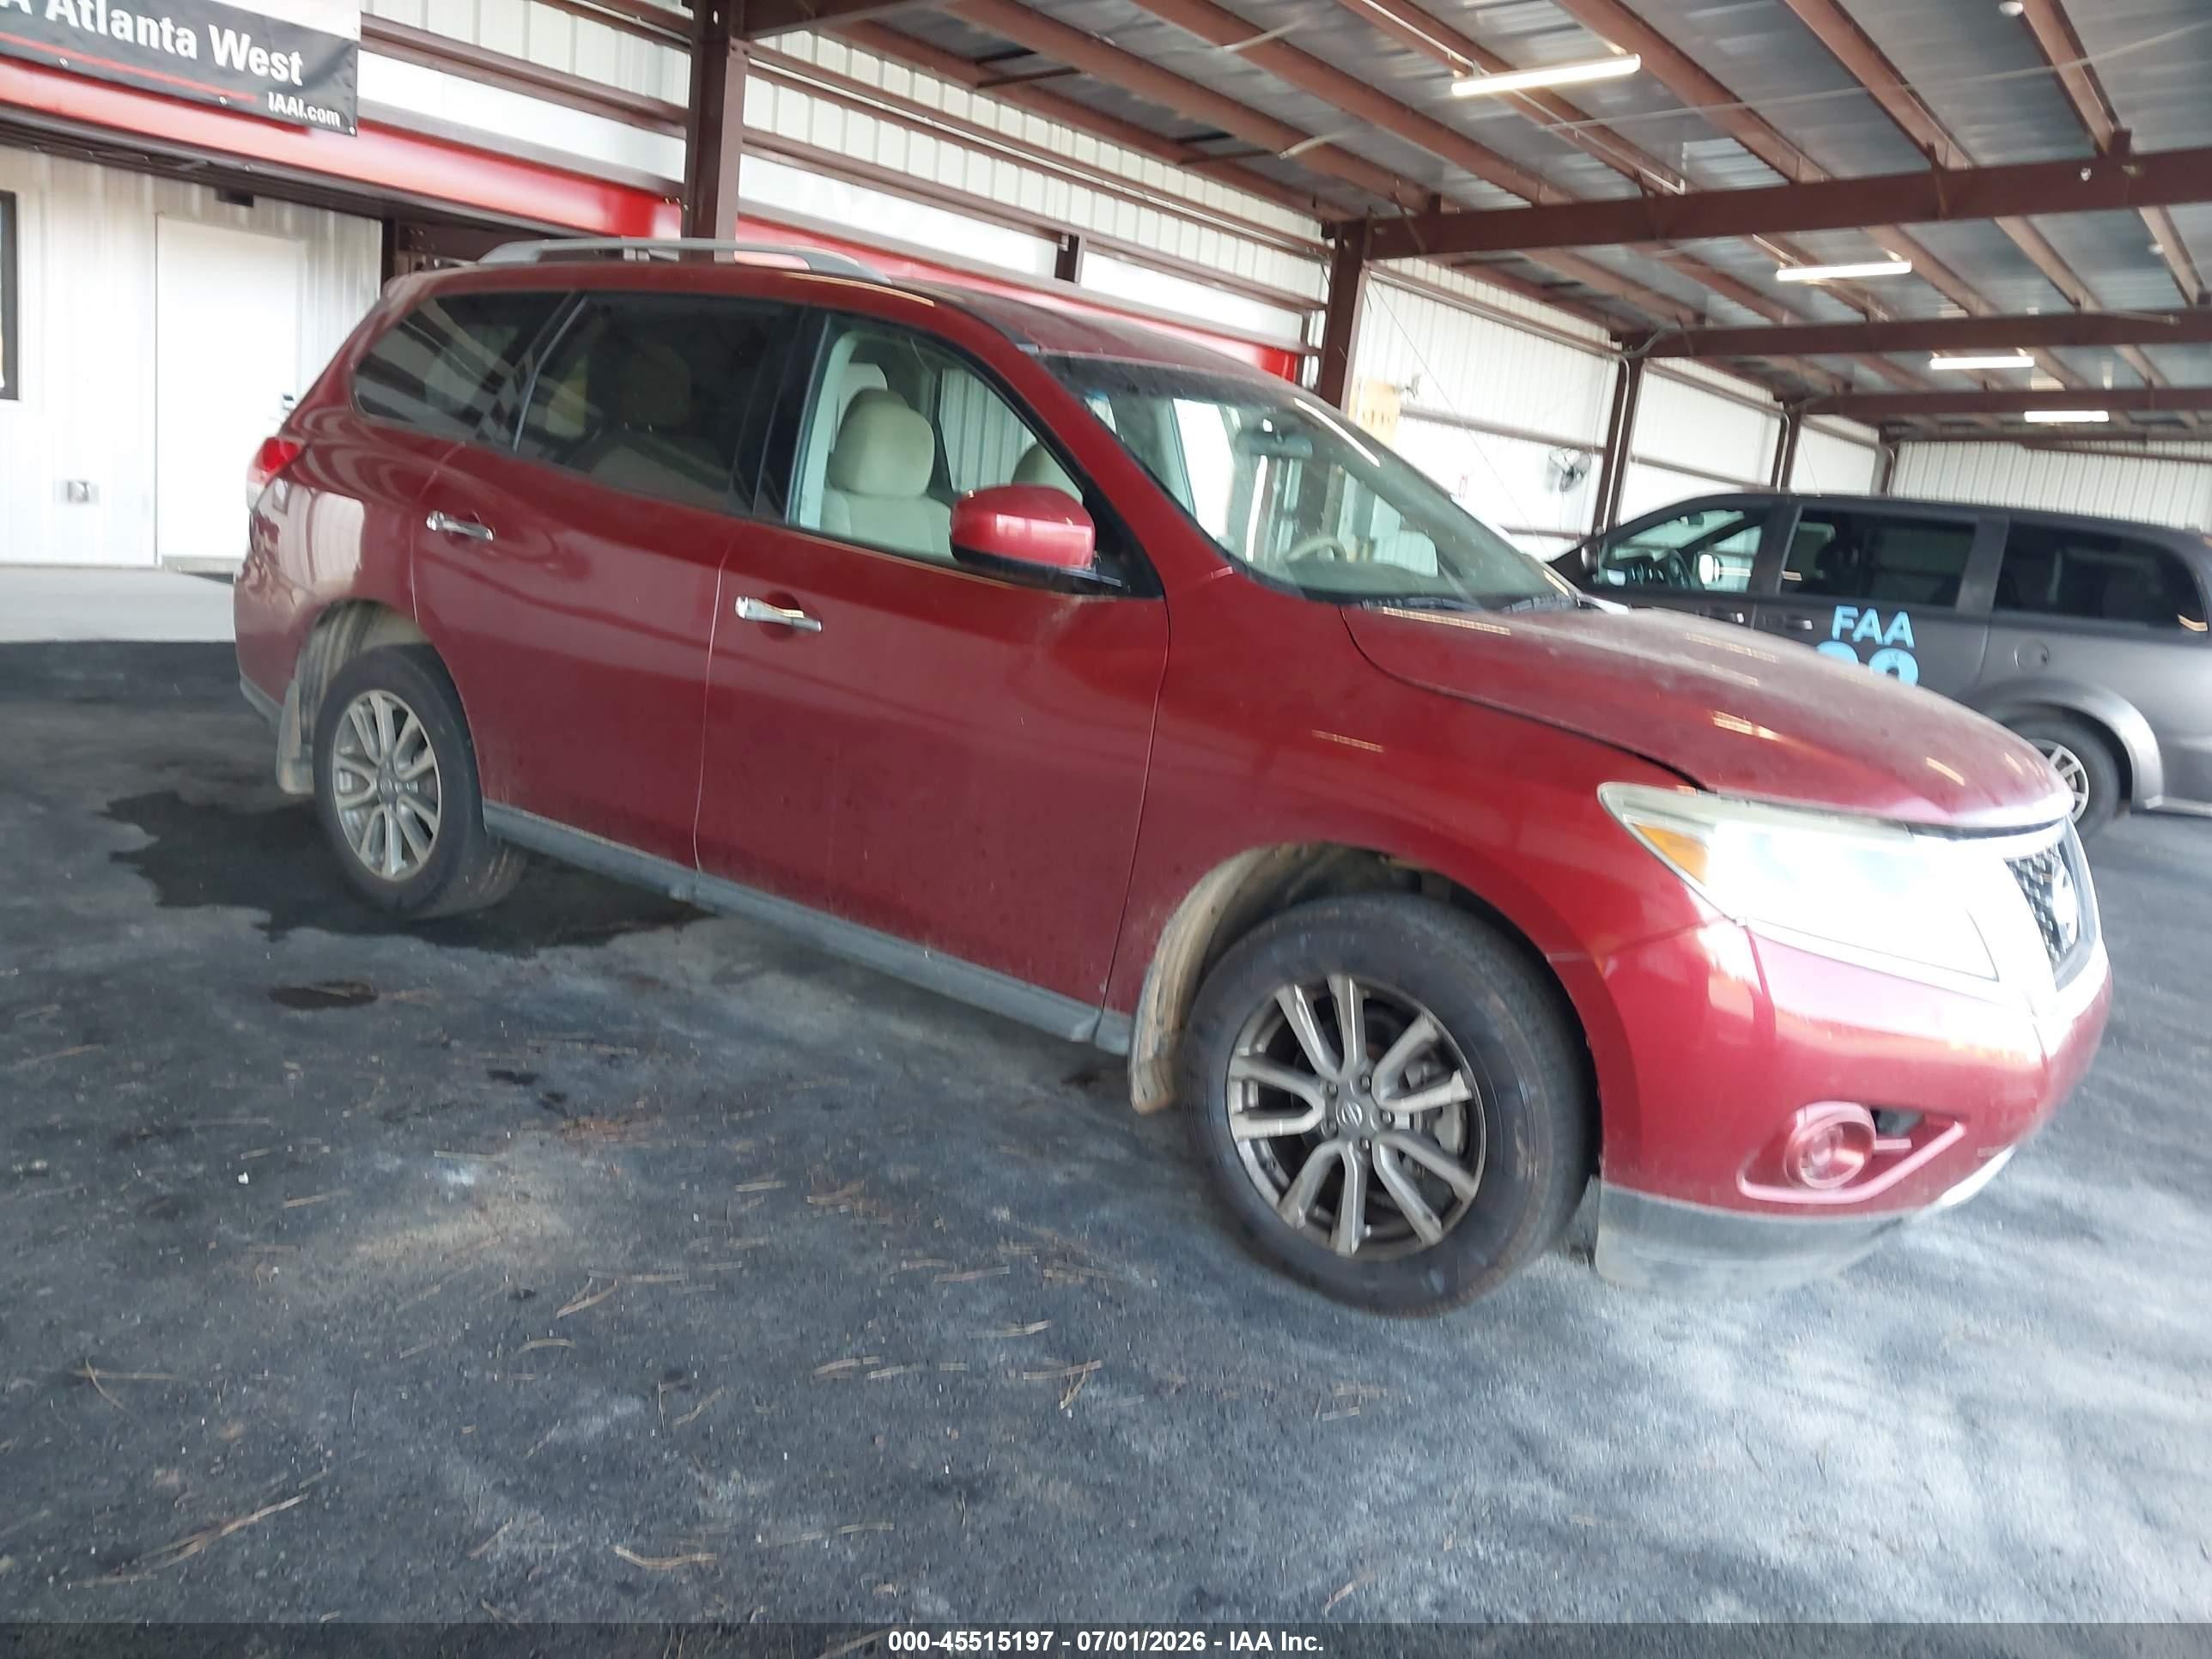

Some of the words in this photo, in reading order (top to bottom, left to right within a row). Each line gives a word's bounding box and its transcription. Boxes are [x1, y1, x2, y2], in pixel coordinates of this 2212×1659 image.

[45, 0, 198, 60] Atlanta
[208, 24, 303, 87] West
[268, 91, 341, 128] IAAI.com
[1831, 605, 1916, 648] FAA
